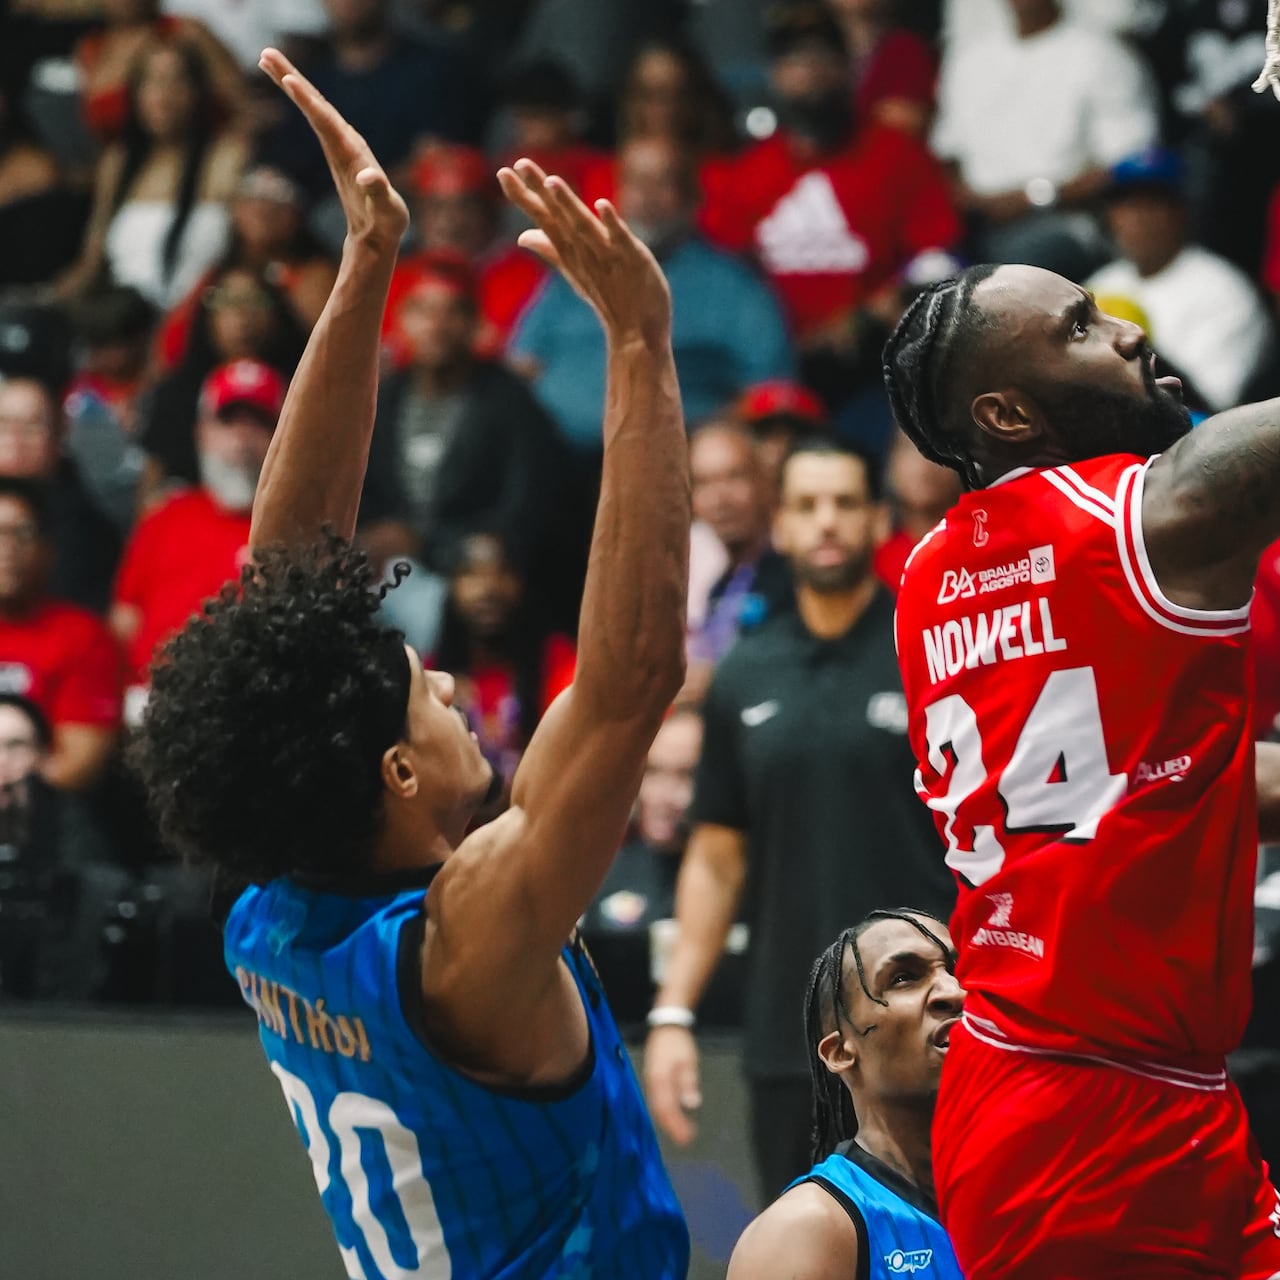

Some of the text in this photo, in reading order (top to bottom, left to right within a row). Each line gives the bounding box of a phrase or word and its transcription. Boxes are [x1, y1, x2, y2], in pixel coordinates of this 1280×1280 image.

[979, 570, 1032, 595] AGOSTO
[922, 596, 1067, 685] NOWELL
[924, 666, 1128, 889] 24
